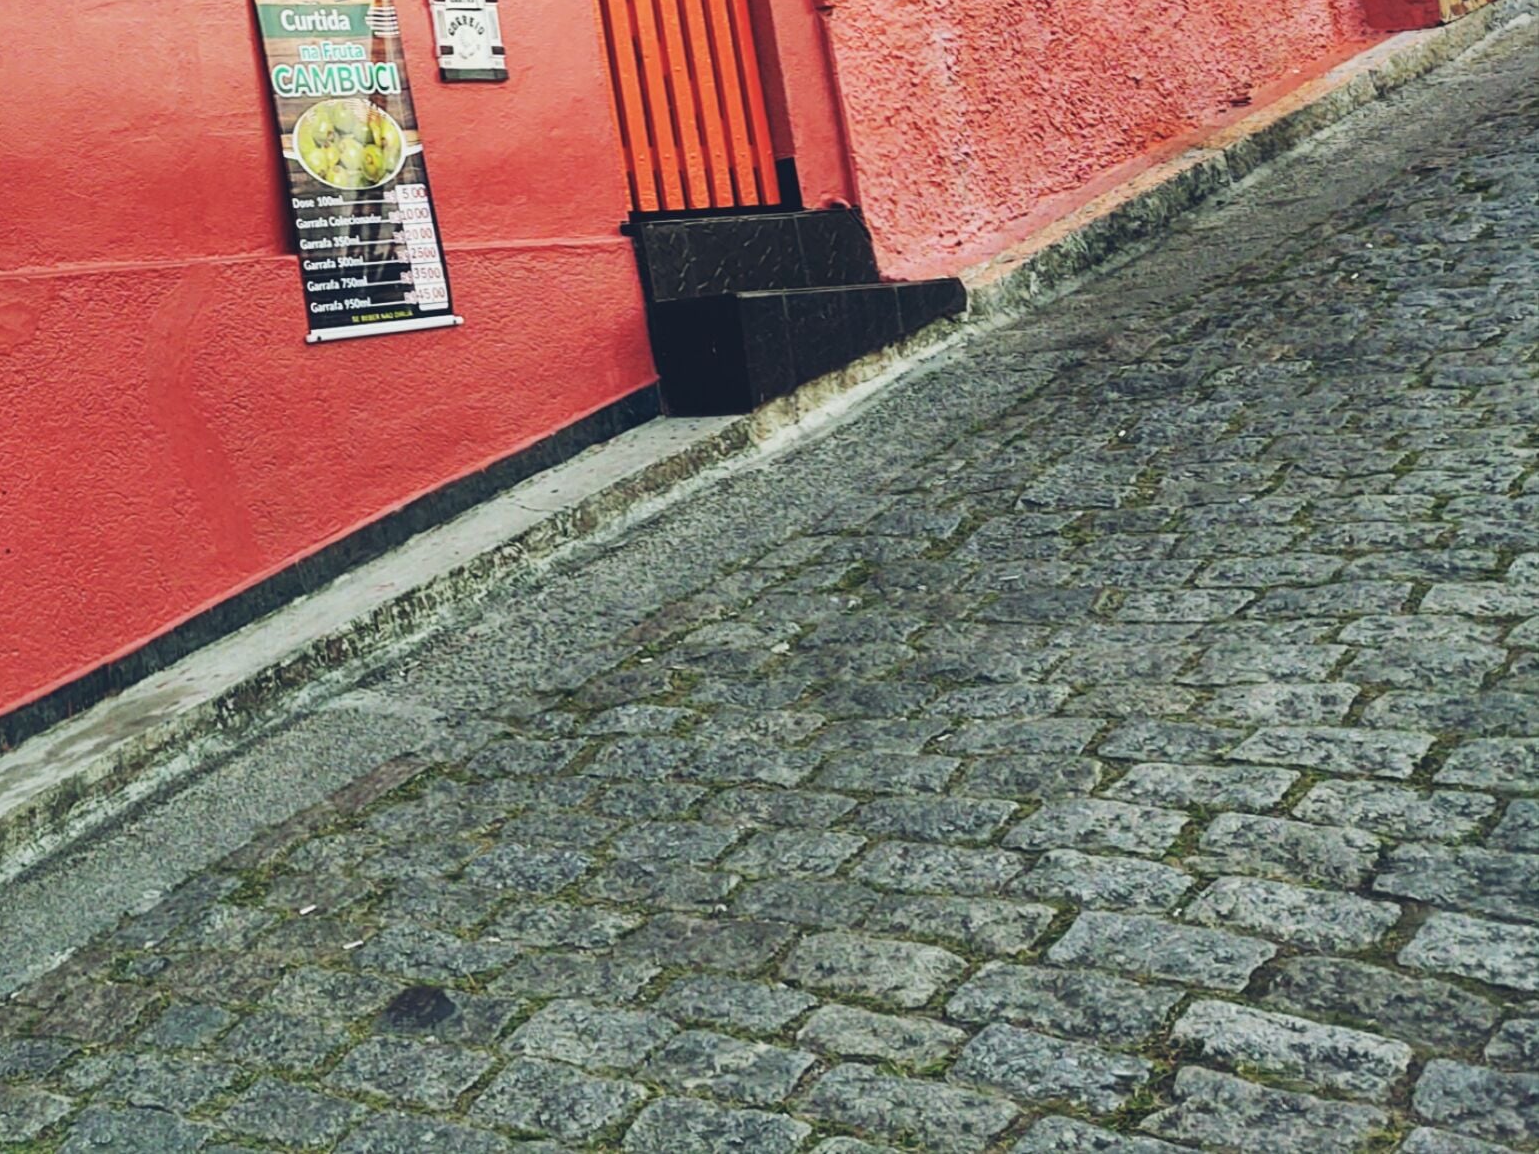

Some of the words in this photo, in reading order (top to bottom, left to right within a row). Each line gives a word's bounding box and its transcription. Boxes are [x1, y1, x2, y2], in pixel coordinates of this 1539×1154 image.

[280, 9, 351, 31] Curtida
[448, 14, 485, 36] CORREIO
[300, 45, 320, 60] na
[321, 41, 365, 59] Fruta
[273, 63, 400, 96] CAMBUCI
[292, 198, 315, 209] Dose
[317, 196, 344, 207] 100ml
[296, 218, 328, 229] Garrafa
[328, 214, 382, 227] Colecionador
[300, 239, 332, 250] Garrafa
[334, 235, 360, 247] 350ml
[303, 259, 336, 271] Garrafa
[337, 256, 364, 267] 500ml
[307, 280, 340, 292] Garrafa
[341, 276, 368, 287] 750ml
[310, 301, 344, 313] Garrafa
[344, 297, 371, 309] 950ml
